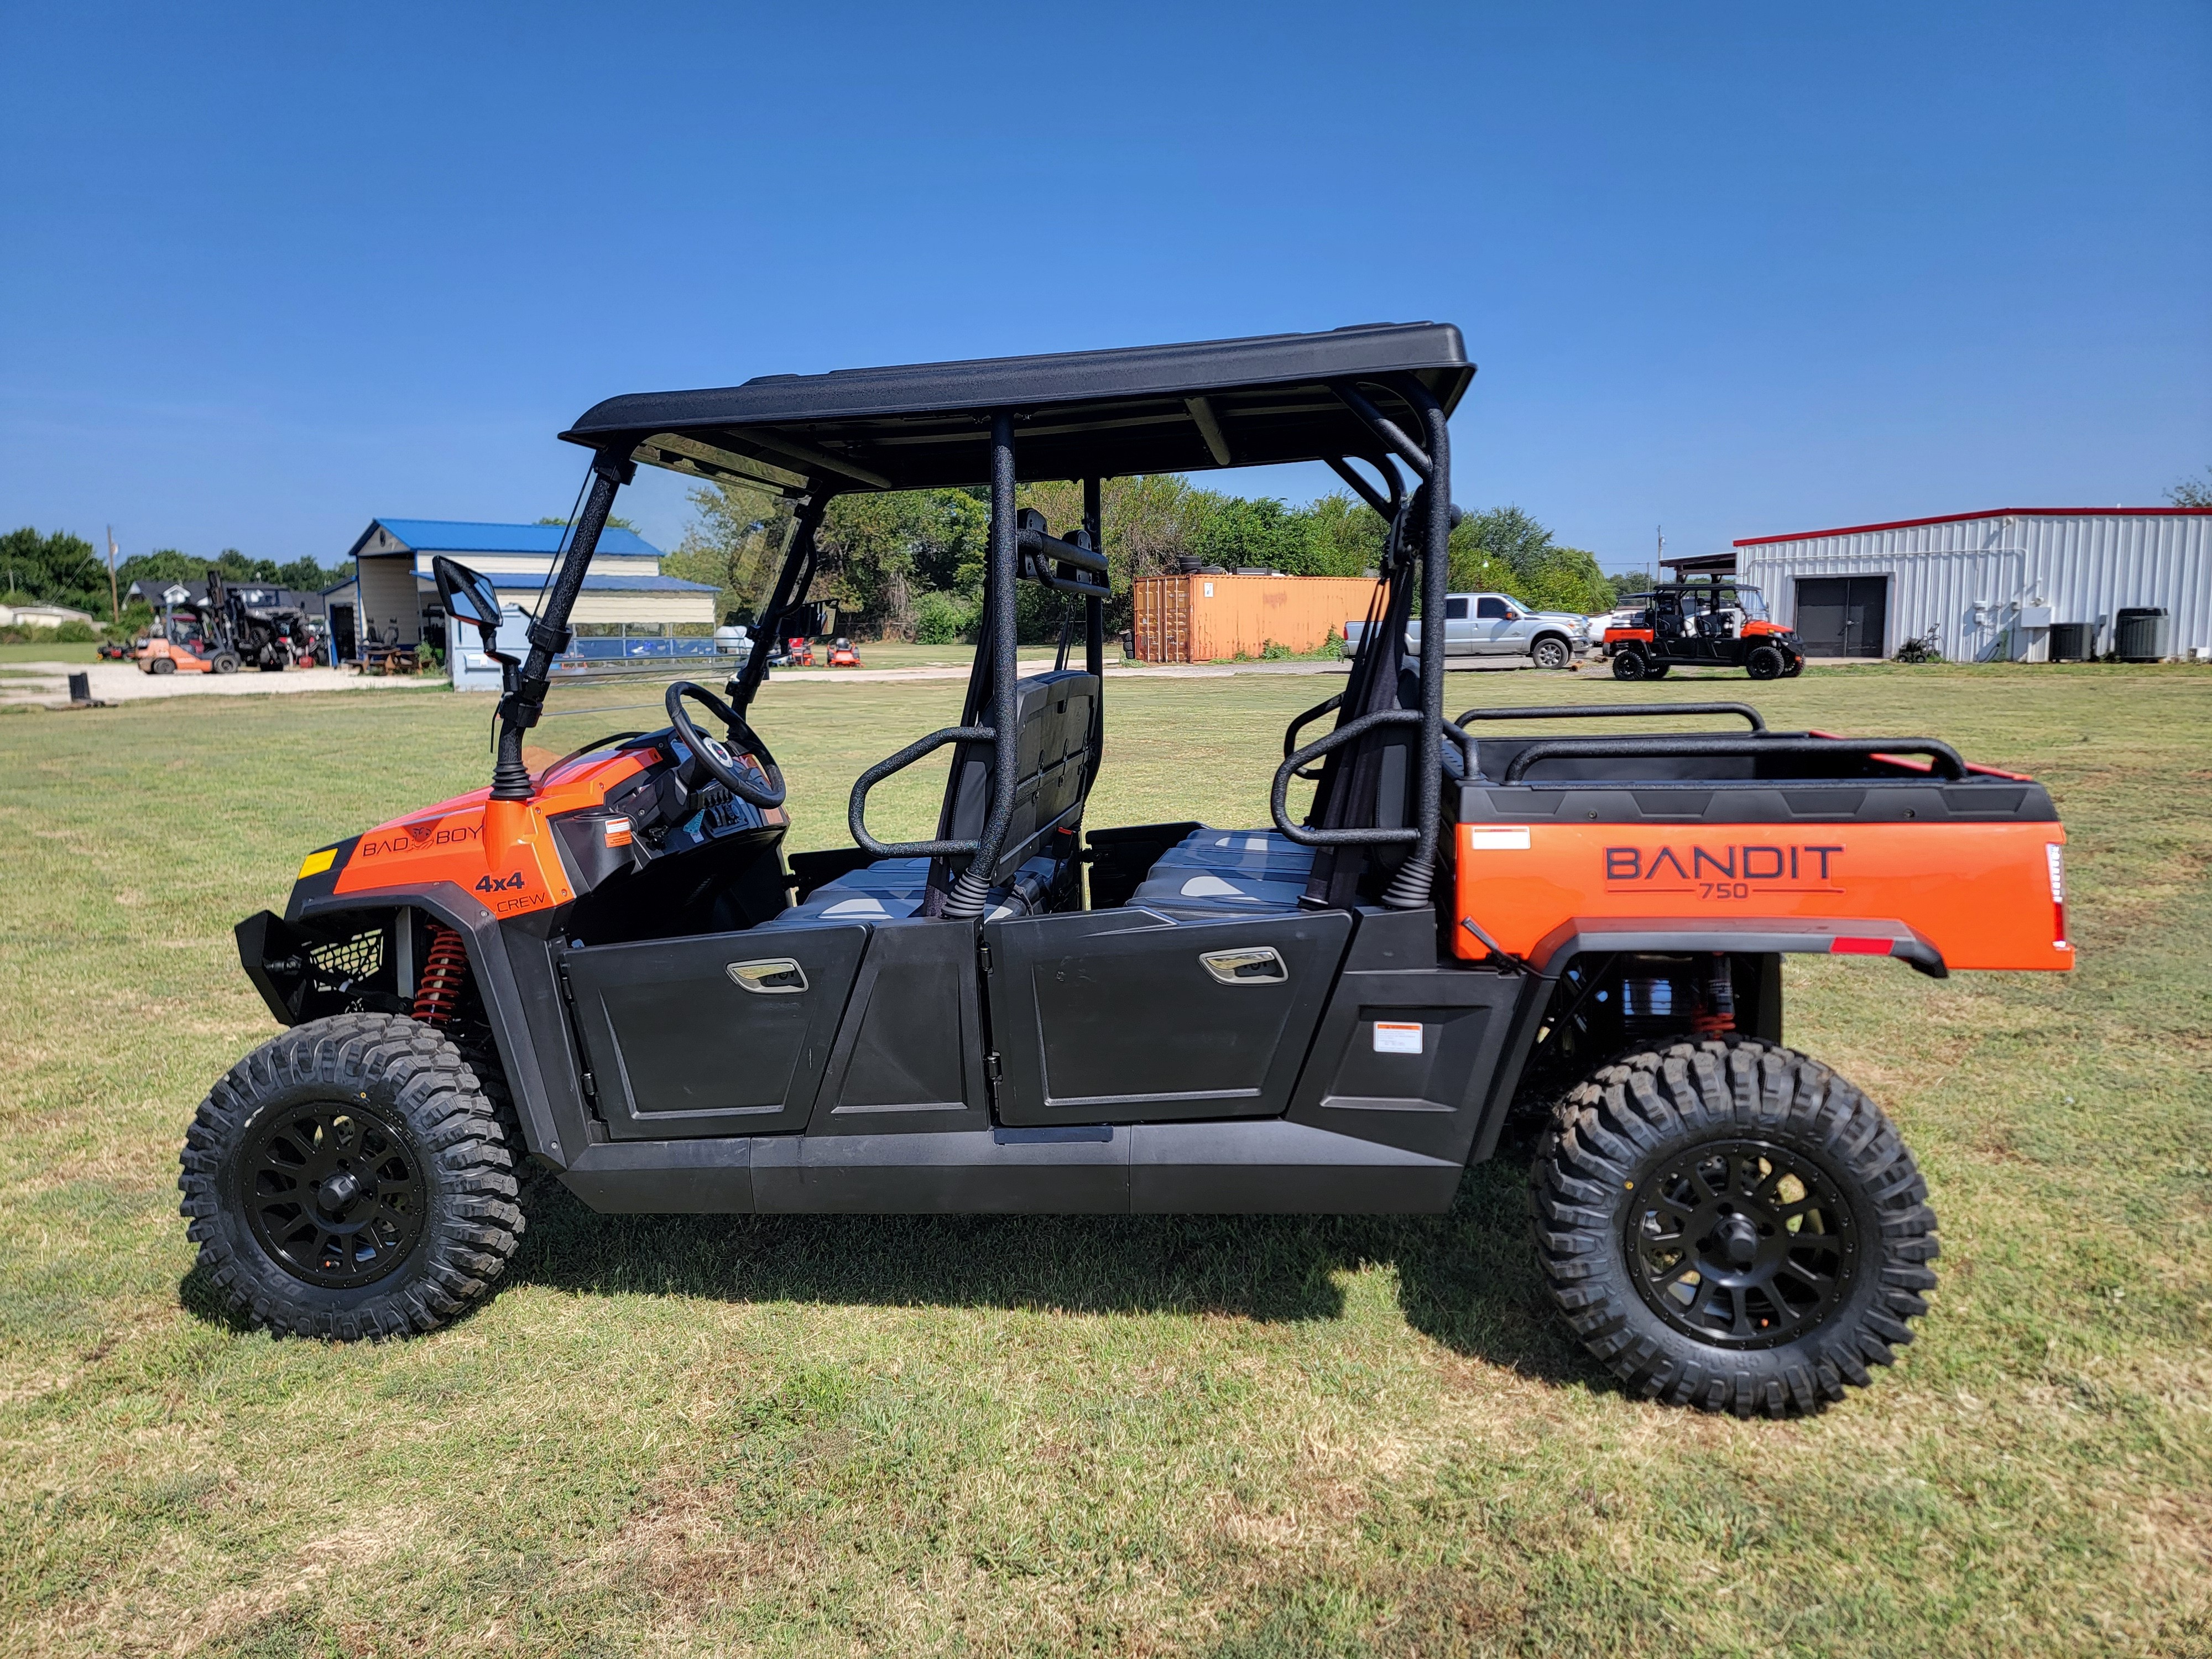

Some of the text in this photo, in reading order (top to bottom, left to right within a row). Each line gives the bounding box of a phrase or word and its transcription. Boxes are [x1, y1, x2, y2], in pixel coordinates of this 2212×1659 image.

[362, 825, 484, 857] BAD BOY
[1606, 846, 1843, 879] BANDIT
[475, 871, 525, 893] 4x4
[1699, 883, 1749, 899] 750
[497, 892, 545, 912] CREW
